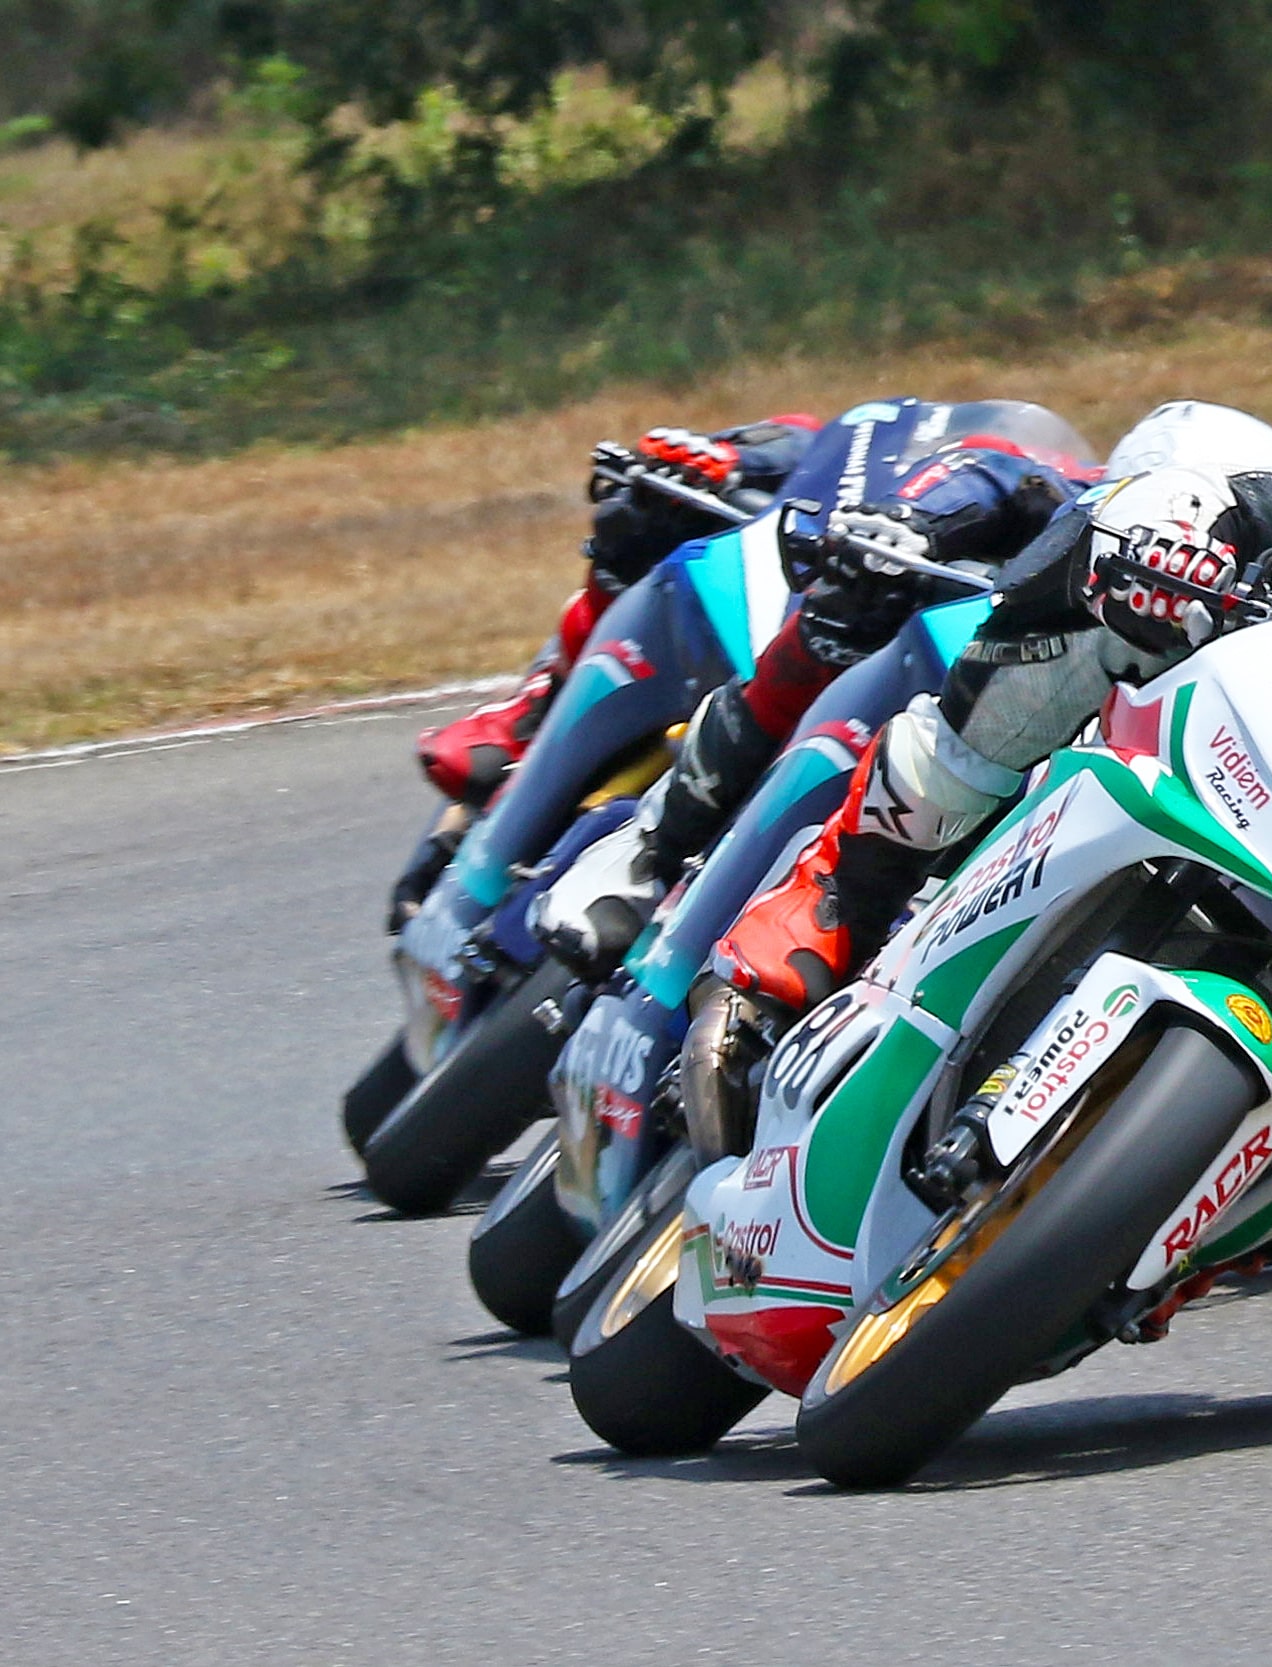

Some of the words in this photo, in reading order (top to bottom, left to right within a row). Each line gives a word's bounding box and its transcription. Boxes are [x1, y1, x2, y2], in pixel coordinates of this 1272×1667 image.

[1205, 766, 1251, 832] Racing
[1210, 725, 1271, 811] Vidiem
[1020, 1021, 1109, 1122] Castrol
